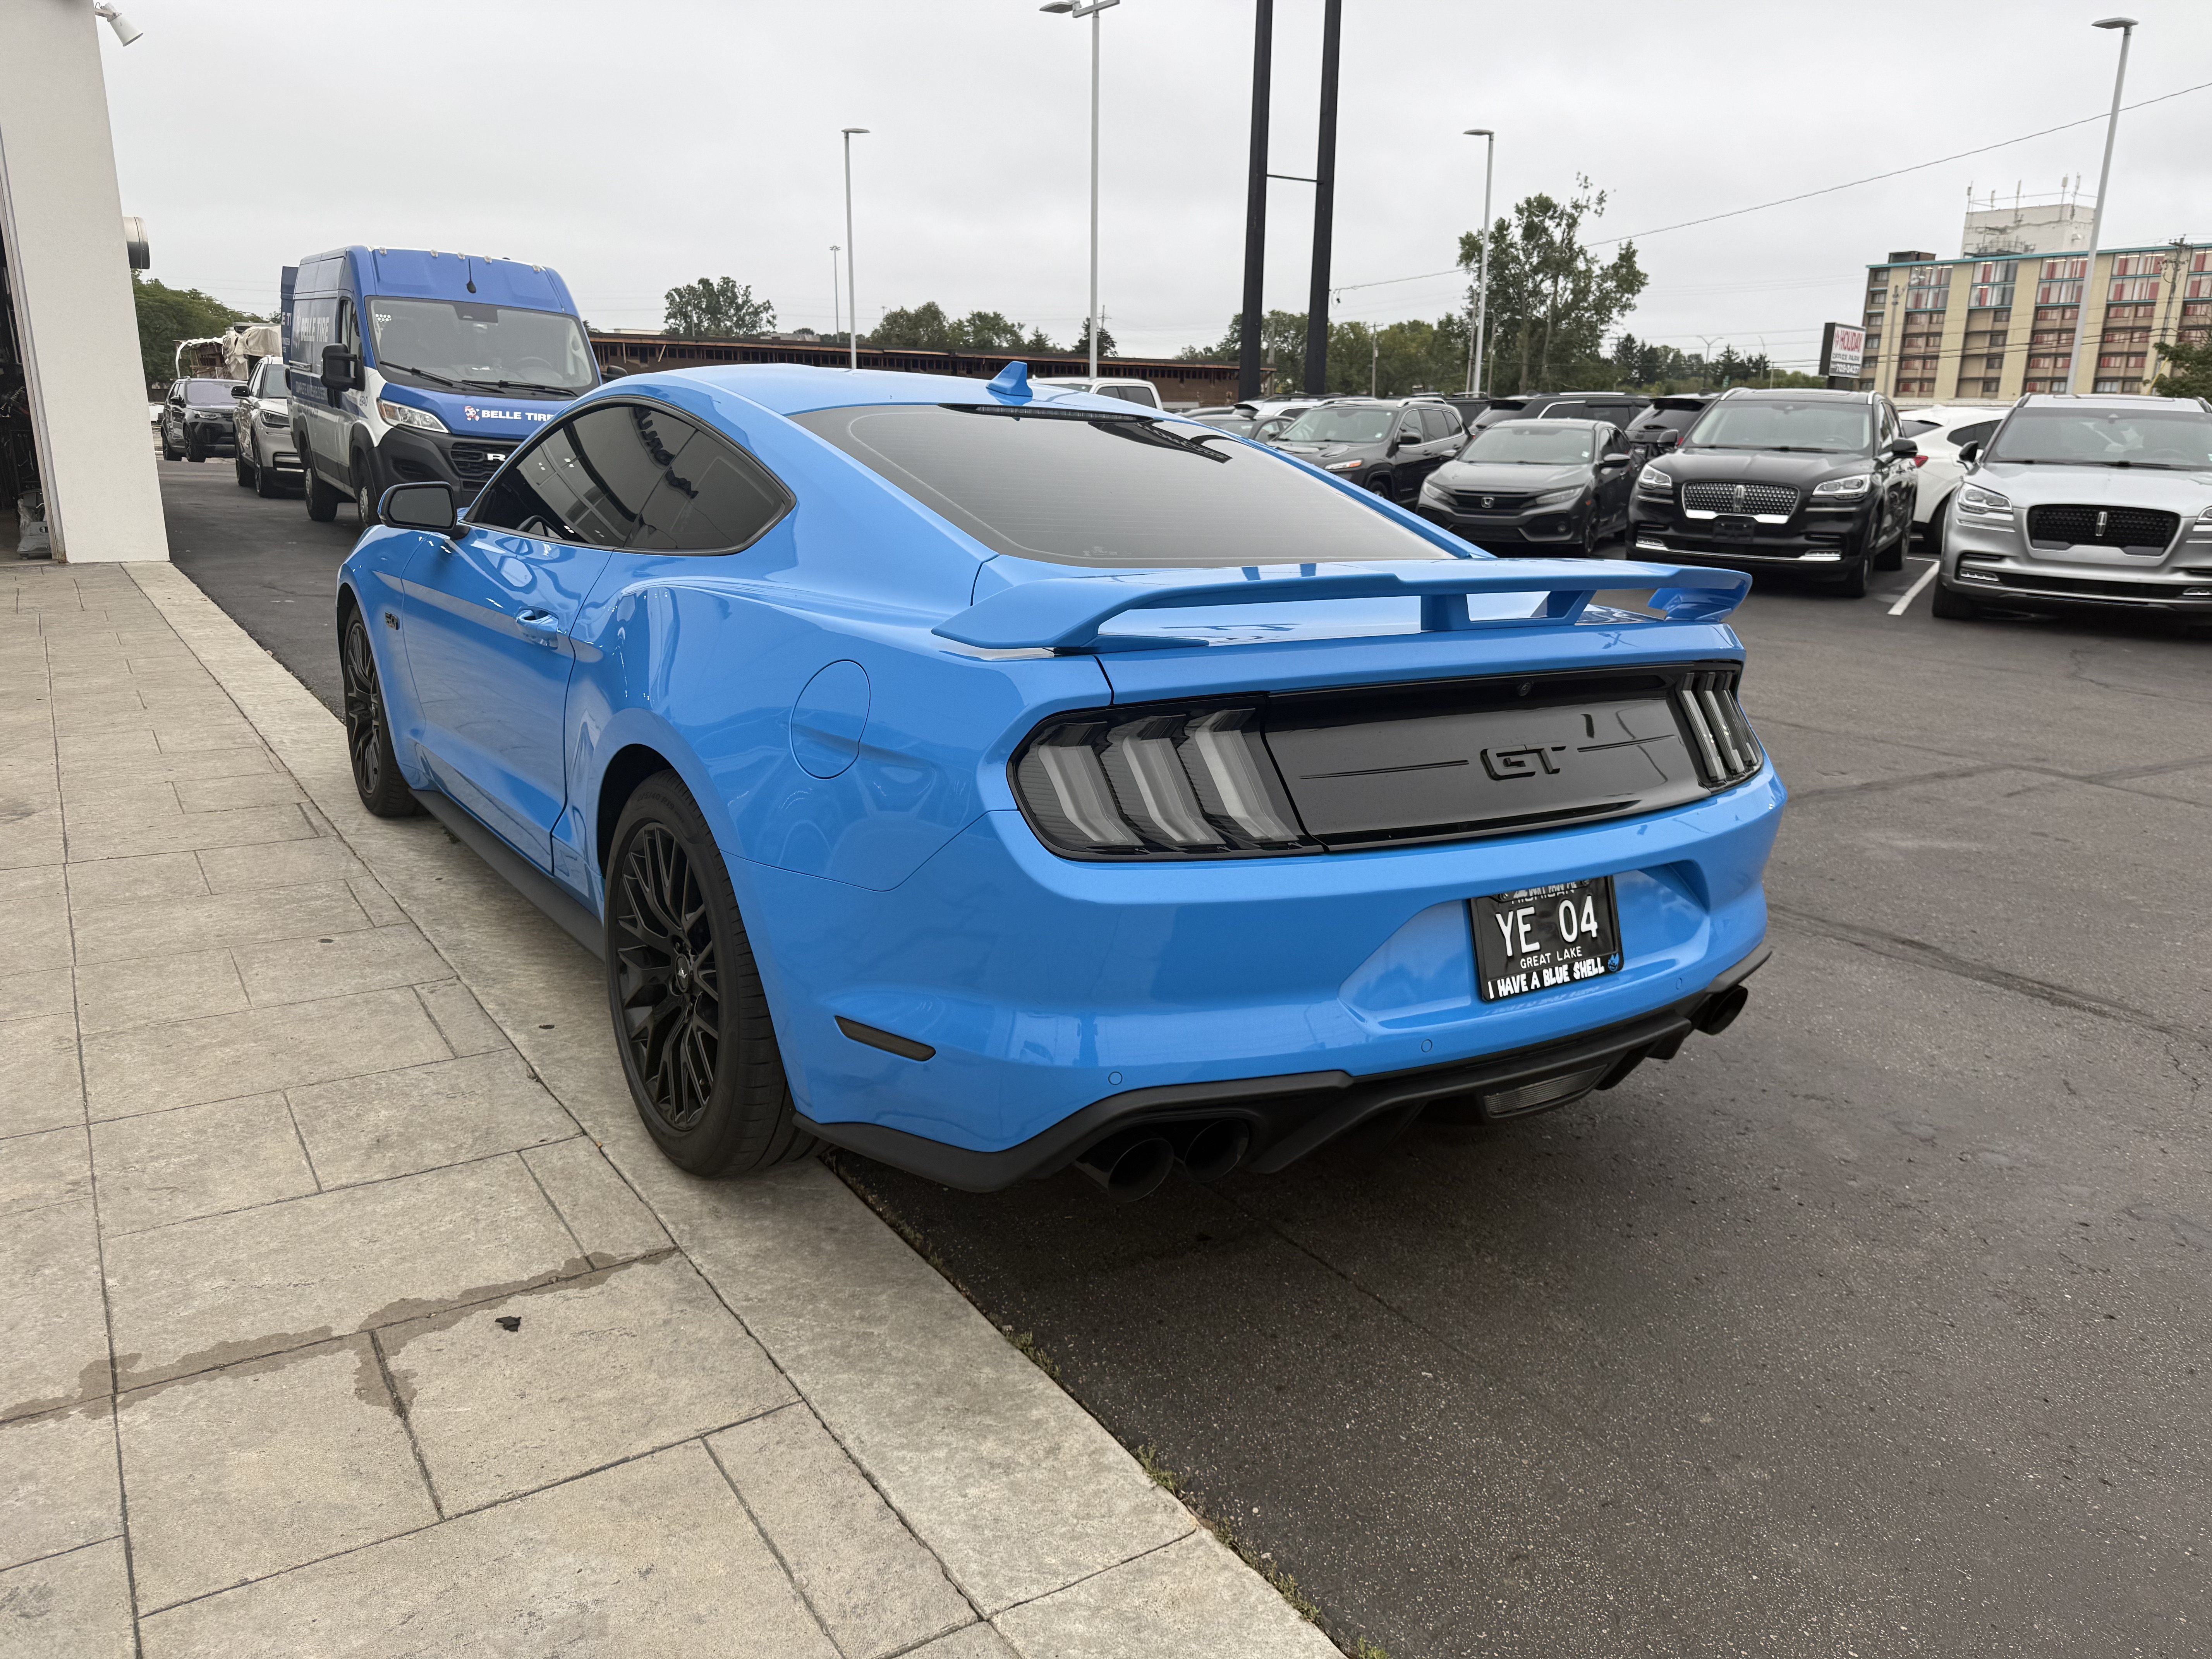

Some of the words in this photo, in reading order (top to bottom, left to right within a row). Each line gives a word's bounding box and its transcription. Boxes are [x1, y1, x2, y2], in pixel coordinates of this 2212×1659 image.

[301, 317, 317, 342] BELLE
[317, 317, 330, 342] TIRE
[481, 410, 522, 420] BELLE
[525, 412, 554, 422] TIRE
[1480, 742, 1566, 781] GT
[1495, 906, 1540, 957] YE
[1558, 895, 1598, 943] 04
[1520, 953, 1551, 969] GREAT
[1556, 946, 1582, 960] LAKE
[1488, 980, 1494, 1000] I
[1498, 973, 1528, 998] HAVE
[1530, 971, 1540, 989] A
[1543, 964, 1570, 986] BLUE
[1573, 957, 1605, 980] SHELL
